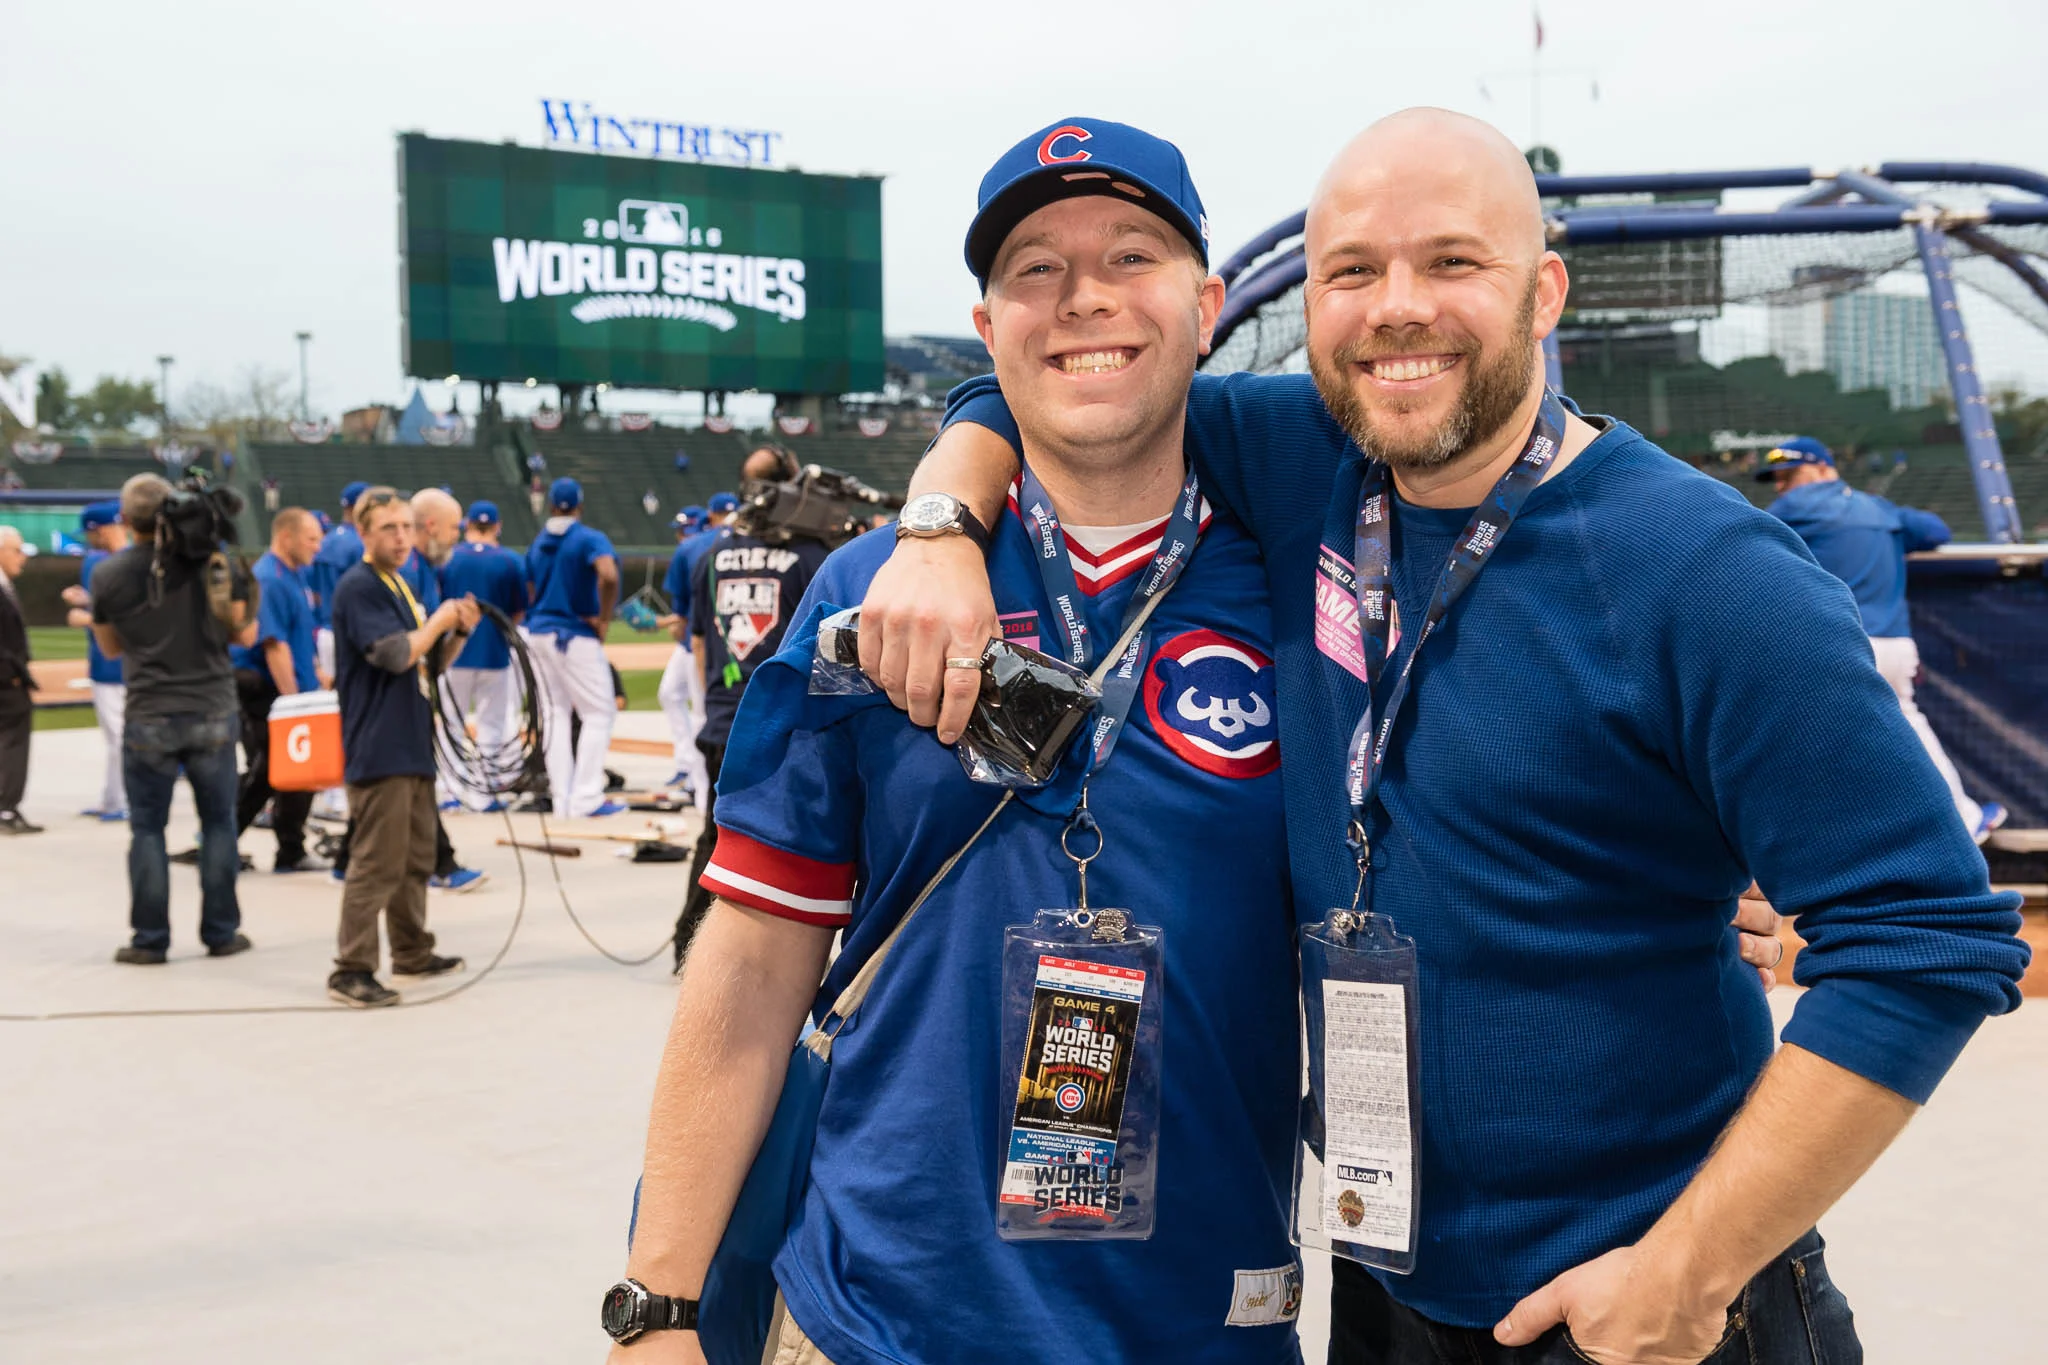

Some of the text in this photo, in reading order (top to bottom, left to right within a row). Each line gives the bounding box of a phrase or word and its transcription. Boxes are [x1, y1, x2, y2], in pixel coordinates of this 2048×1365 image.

[541, 98, 782, 164] WINTRUST
[1036, 125, 1093, 167] C
[492, 237, 806, 321] WORLD SERIES
[1523, 435, 1542, 462] SERIES
[1533, 439, 1554, 466] WORLD
[1365, 497, 1373, 525] WORLD
[1373, 494, 1382, 523] SERIES
[1040, 524, 1057, 559] SERIES
[1465, 520, 1486, 552] SERIES
[1475, 524, 1499, 556] WORLD
[714, 546, 800, 574] CREW
[1144, 539, 1186, 598] WORLD SERIES
[1322, 559, 1352, 584] WORLD
[1366, 590, 1376, 620] WORLD
[1375, 590, 1385, 621] SERIES
[1004, 621, 1033, 634] 2016
[1056, 594, 1084, 664] WORLD SERIES
[1117, 656, 1136, 679] WORLD
[286, 723, 312, 764] G
[1093, 716, 1115, 746] SERIES
[1350, 769, 1364, 806] WORLD
[1053, 996, 1101, 1012] GAME
[1104, 1004, 1117, 1015] 4
[1045, 1025, 1115, 1050] WORLD
[1042, 1043, 1113, 1073] SERIES
[1019, 1116, 1051, 1125] AMERICAN
[1026, 1133, 1065, 1143] NATIONAL
[1032, 1140, 1073, 1149] AMERICAN
[1034, 1165, 1123, 1187] WORLD
[1338, 1166, 1377, 1183] MLB.com
[1034, 1186, 1123, 1215] SERIES
